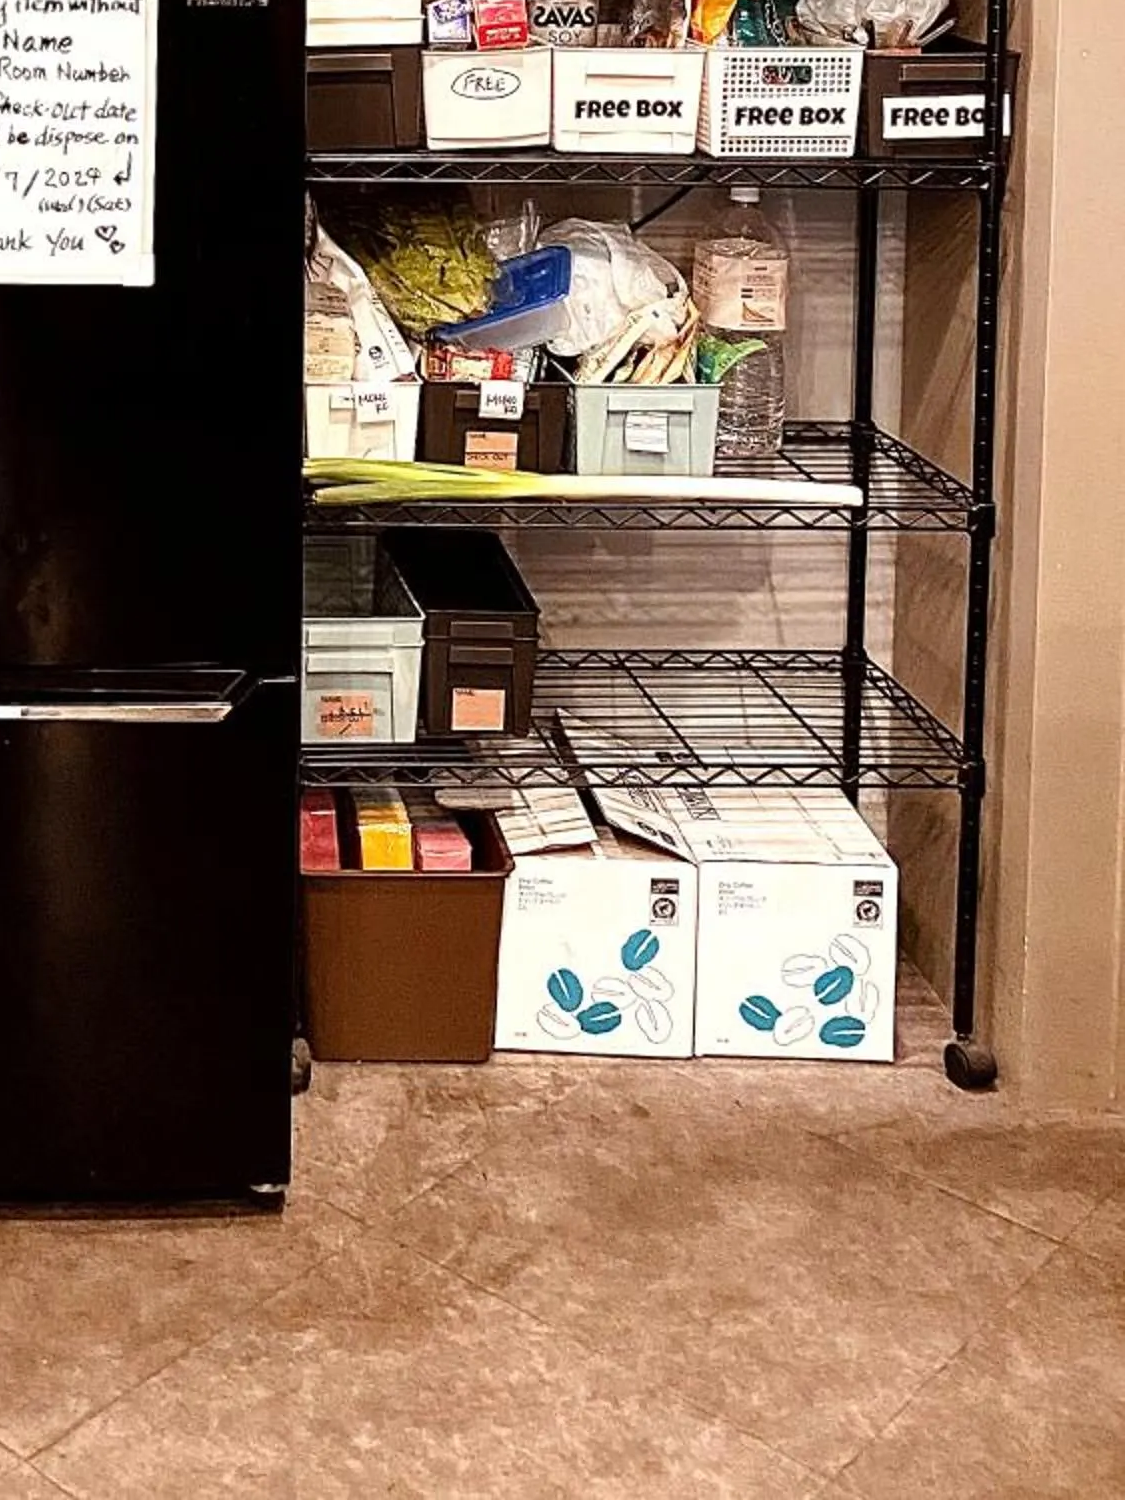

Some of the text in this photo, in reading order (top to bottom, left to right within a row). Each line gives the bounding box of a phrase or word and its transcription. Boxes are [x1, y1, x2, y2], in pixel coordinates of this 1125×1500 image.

[533, 5, 595, 28] SAVAS
[2, 28, 73, 53] Name
[548, 29, 582, 44] SOY
[56, 61, 131, 83] Number
[463, 71, 506, 93] FREE
[94, 96, 139, 122] date
[636, 100, 684, 119] BOX
[799, 106, 846, 125] BOX
[955, 107, 986, 126] BO
[6, 124, 31, 146] be
[34, 124, 110, 156] dispose
[114, 132, 140, 146] on
[46, 227, 86, 257] You
